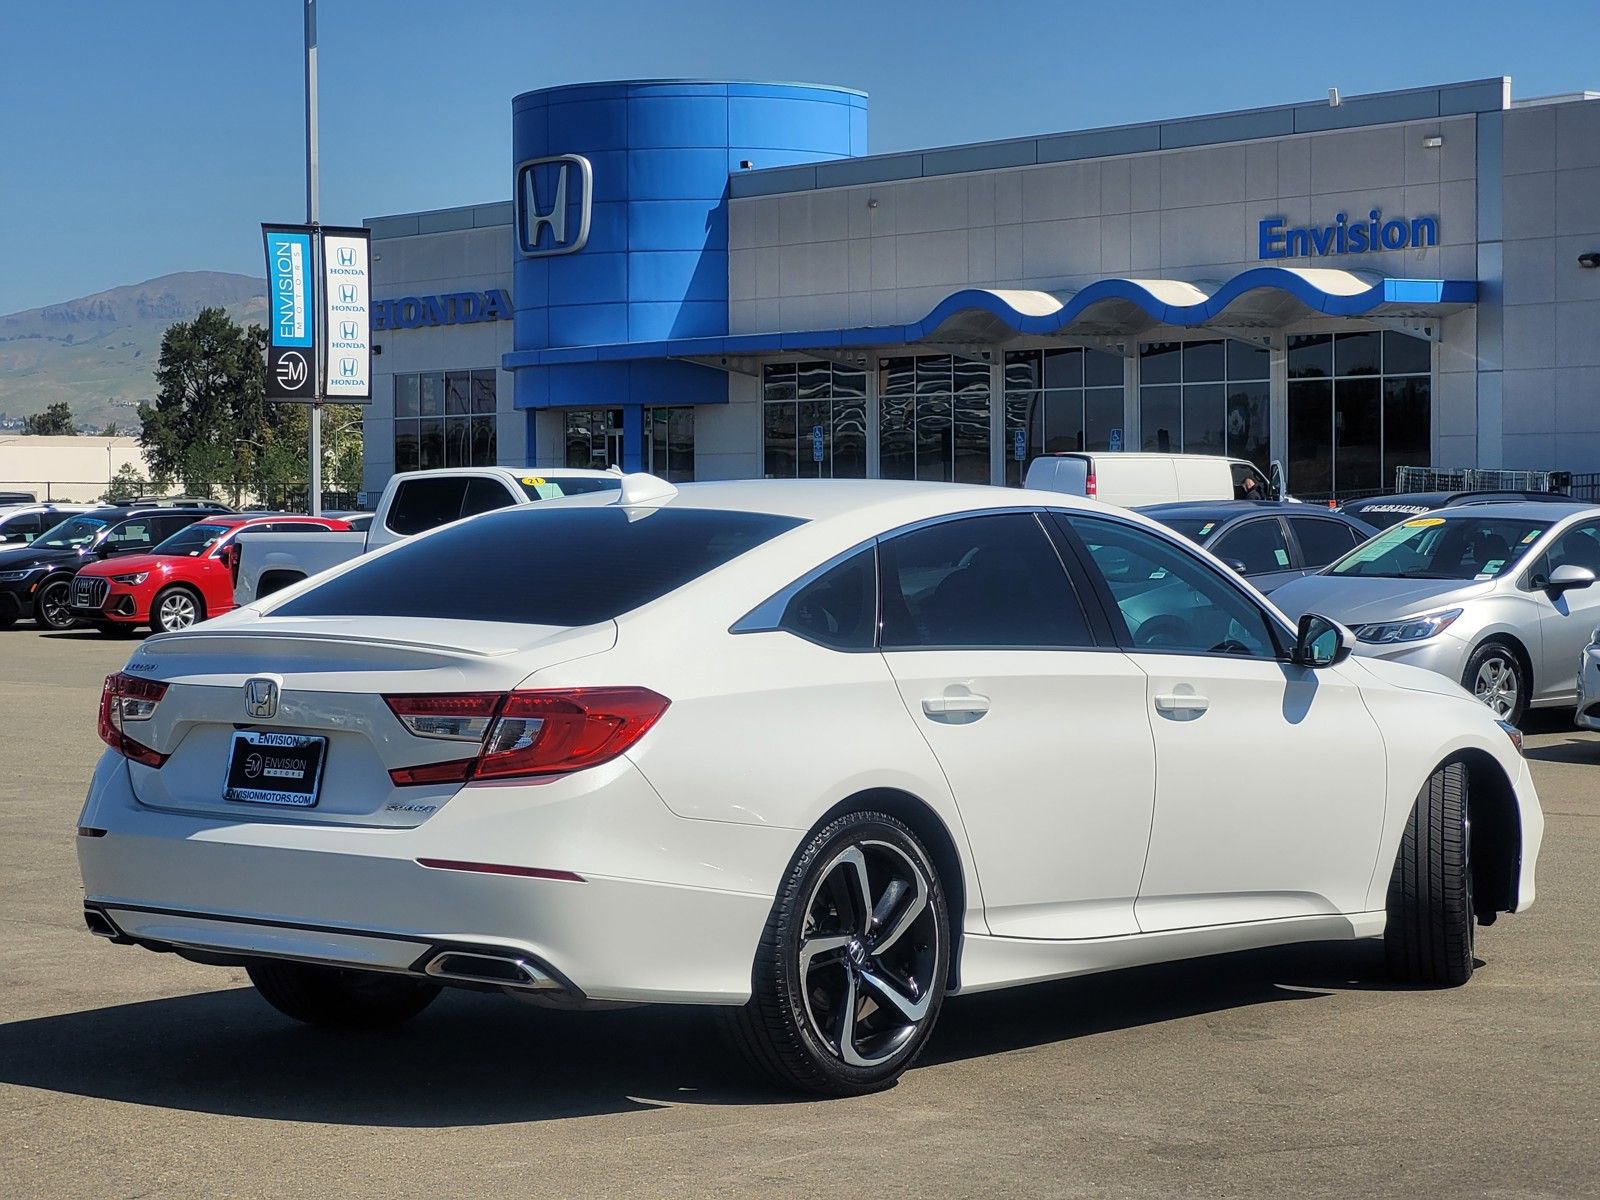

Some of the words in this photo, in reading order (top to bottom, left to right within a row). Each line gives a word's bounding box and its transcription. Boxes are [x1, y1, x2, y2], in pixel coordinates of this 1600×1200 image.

[1258, 208, 1438, 260] Envision
[276, 242, 294, 338] ENVISION
[294, 252, 303, 330] MOTORS
[372, 289, 514, 331] HONDA
[1373, 504, 1430, 512] CERTIFIED
[258, 735, 299, 746] ENVISION
[264, 756, 307, 769] ENVISION
